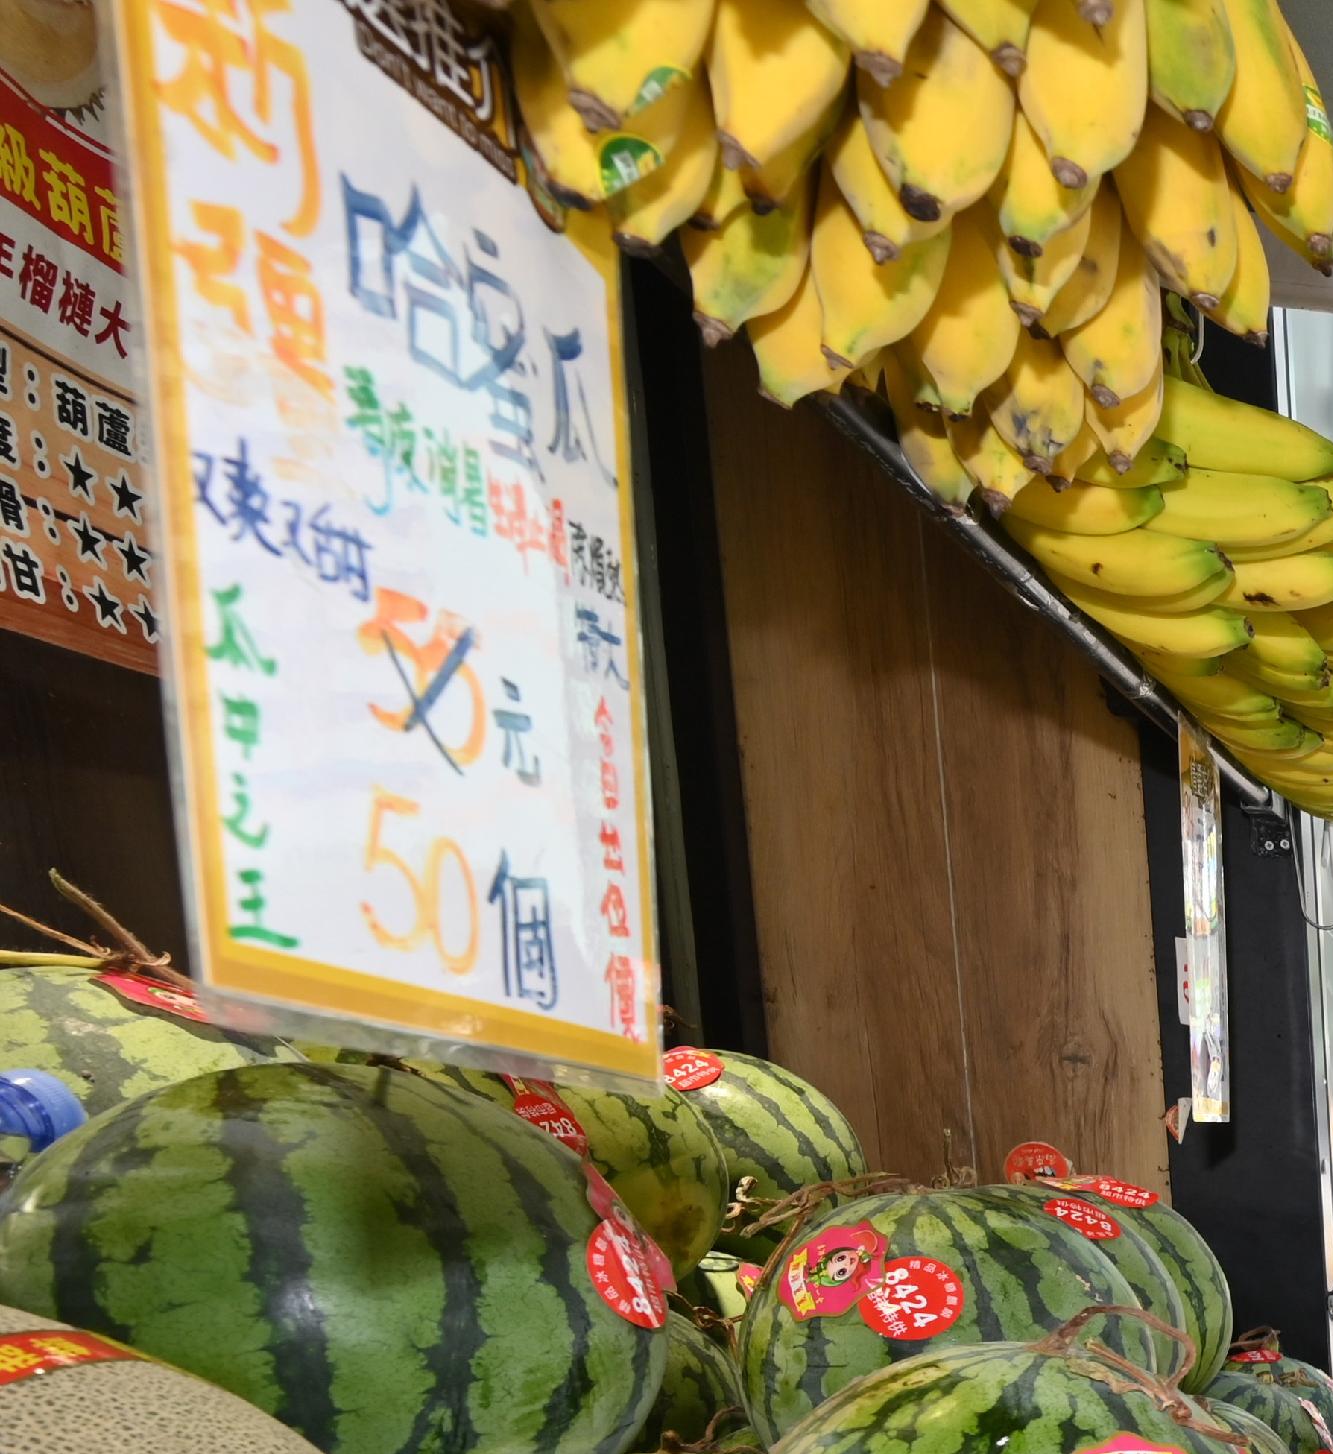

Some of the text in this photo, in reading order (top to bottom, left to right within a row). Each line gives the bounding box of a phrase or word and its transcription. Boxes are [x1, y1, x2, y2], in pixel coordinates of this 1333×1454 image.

[360, 783, 479, 975] 50
[662, 1058, 710, 1086] 8424
[1099, 1182, 1151, 1200] 8424
[1054, 1206, 1112, 1232] 8424
[884, 1267, 939, 1328] 8424
